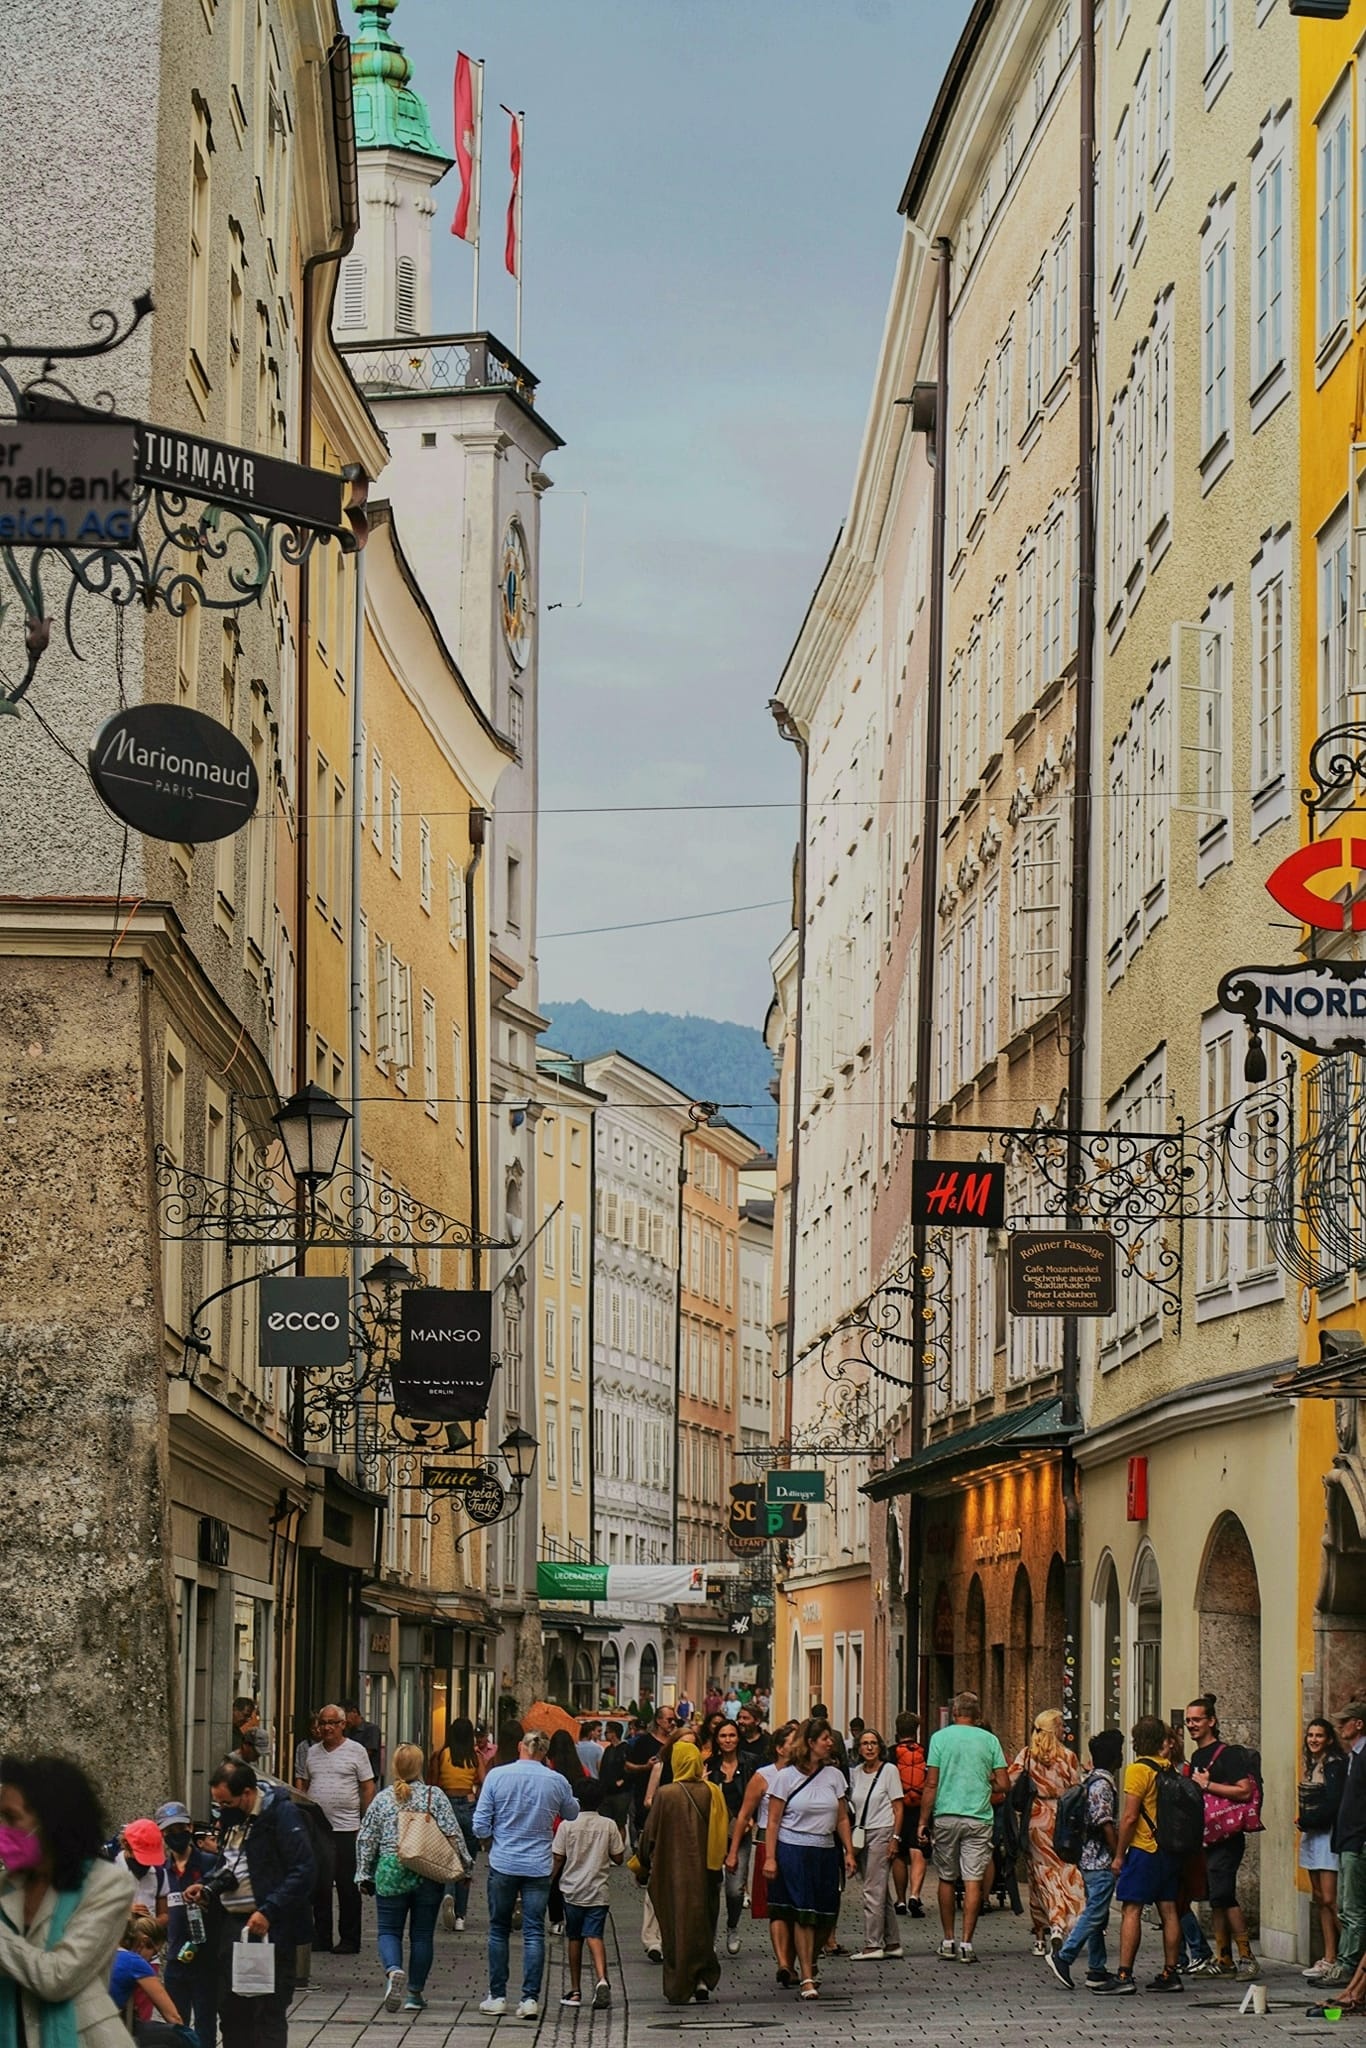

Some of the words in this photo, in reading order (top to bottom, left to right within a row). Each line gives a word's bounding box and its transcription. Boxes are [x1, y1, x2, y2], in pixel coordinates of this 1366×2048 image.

[78, 509, 130, 540] AG
[100, 728, 250, 789] Marionnaud
[155, 779, 195, 800] PARIS
[1265, 986, 1366, 1018] NORD
[926, 1171, 993, 1217] H&M
[1064, 1239, 1105, 1261] Passage
[1022, 1274, 1067, 1282] Geschenke
[1046, 1265, 1099, 1273] Mozartwinkel
[268, 1312, 340, 1331] ecco
[410, 1329, 481, 1342] MANGO
